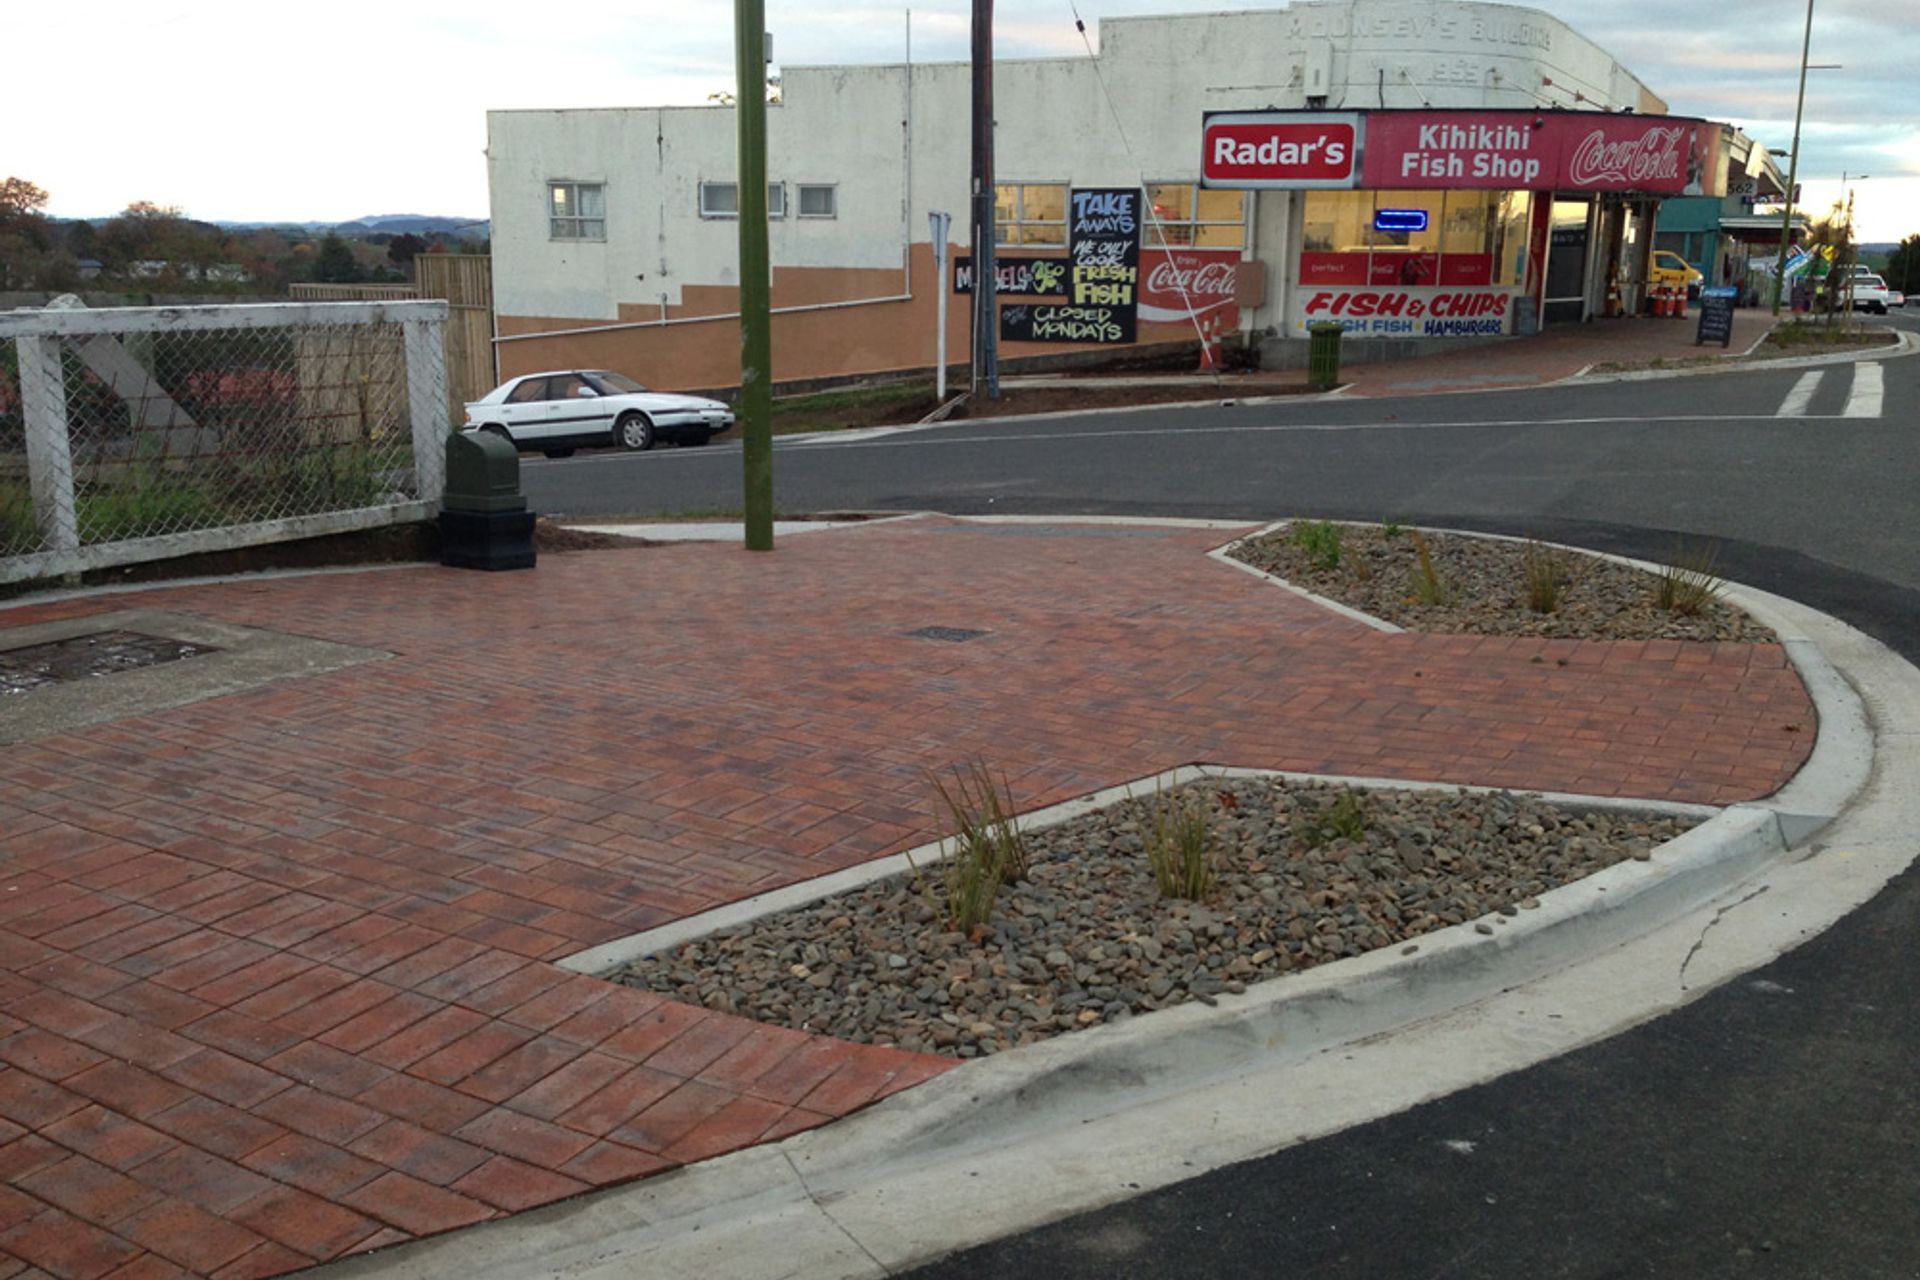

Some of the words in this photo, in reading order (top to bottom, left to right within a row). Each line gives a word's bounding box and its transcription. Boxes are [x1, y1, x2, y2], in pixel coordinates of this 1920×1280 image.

[1418, 125, 1530, 151] Kihikihi
[1213, 138, 1346, 166] Radar's
[1402, 153, 1463, 178] Fish
[1473, 155, 1540, 183] Shop
[1073, 192, 1134, 218] TAKE
[1074, 216, 1136, 234] AWAYS
[1098, 240, 1133, 256] ONLY
[1077, 254, 1124, 267] COOK
[1073, 265, 1137, 284] FRESH
[1075, 283, 1132, 305] FISH
[1034, 306, 1110, 322] CLOSED
[1305, 293, 1408, 316] FISH
[1406, 299, 1426, 317] &
[1429, 293, 1509, 316] CHIPS
[1033, 321, 1123, 340] MONDAYS
[1373, 320, 1413, 332] FISH
[1424, 320, 1502, 335] HAMBURGERS
